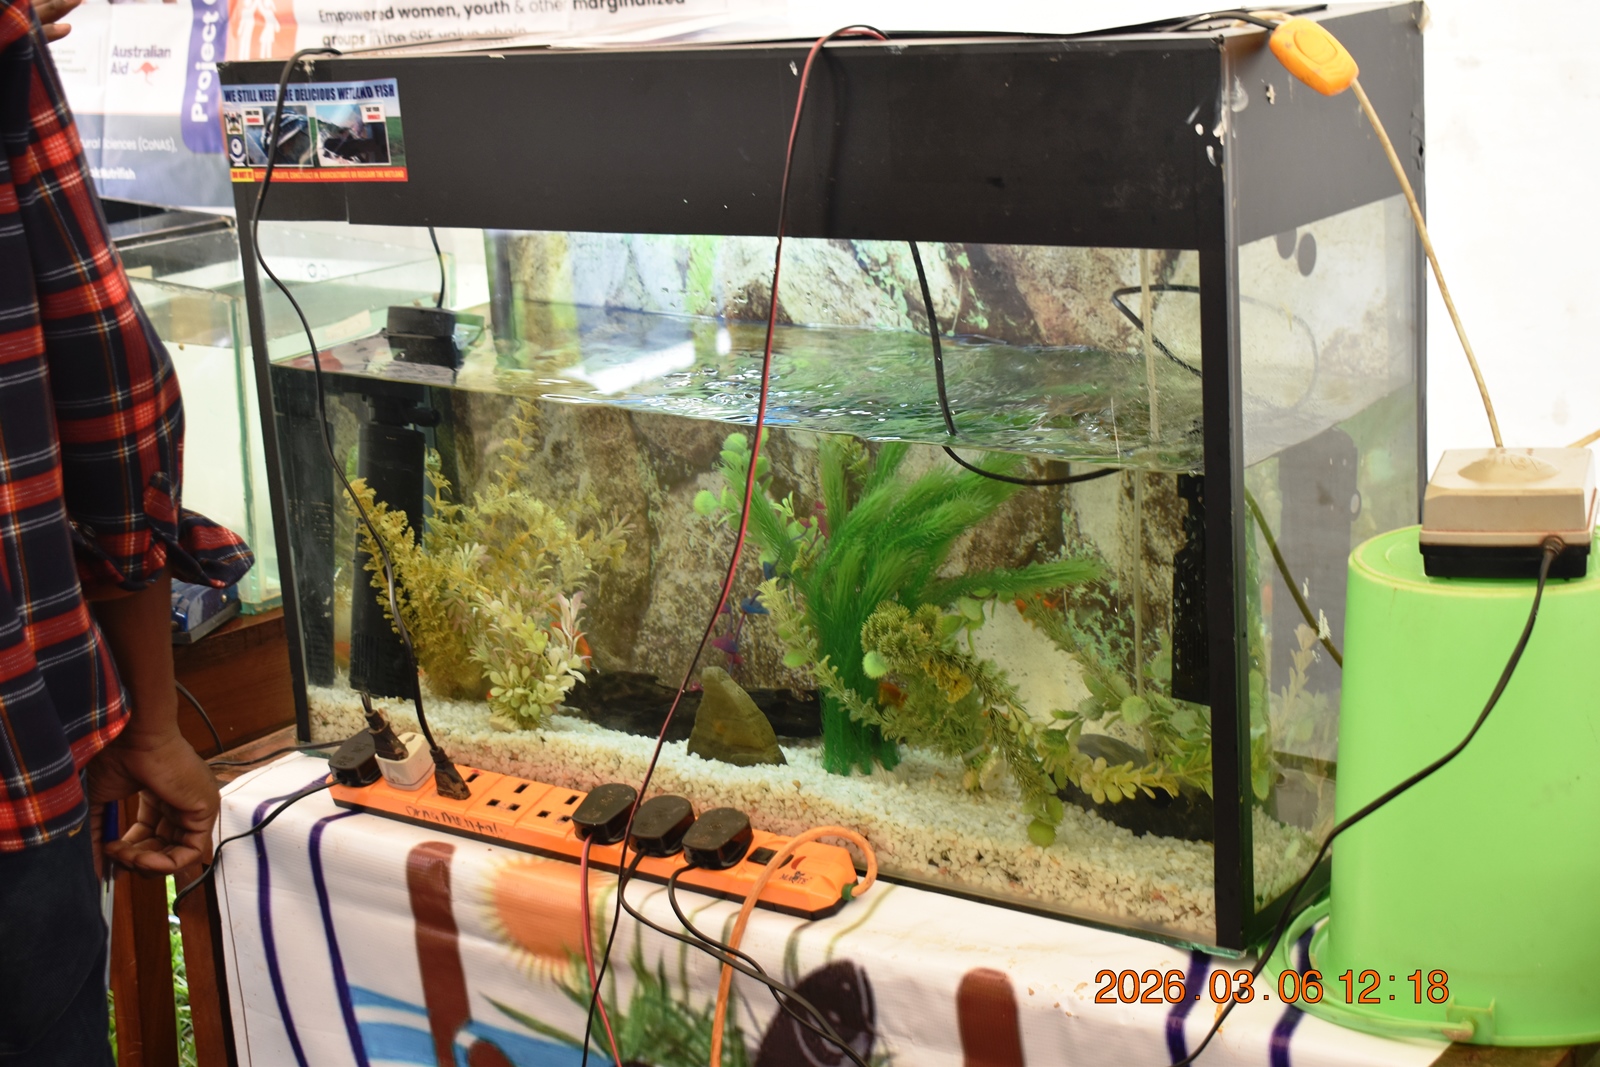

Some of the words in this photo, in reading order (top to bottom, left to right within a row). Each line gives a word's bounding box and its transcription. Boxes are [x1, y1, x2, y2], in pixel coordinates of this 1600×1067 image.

[318, 6, 395, 26] Empowered
[397, 5, 461, 19] women,
[465, 1, 510, 20] youth
[530, 2, 562, 13] othe
[322, 34, 366, 48] groups
[112, 45, 172, 58] Australian
[111, 62, 129, 75] Aid
[190, 10, 220, 123] Project
[223, 89, 237, 102] WE
[237, 89, 258, 102] STILL
[295, 87, 336, 101] DELICIOUS
[374, 83, 396, 98] FISH
